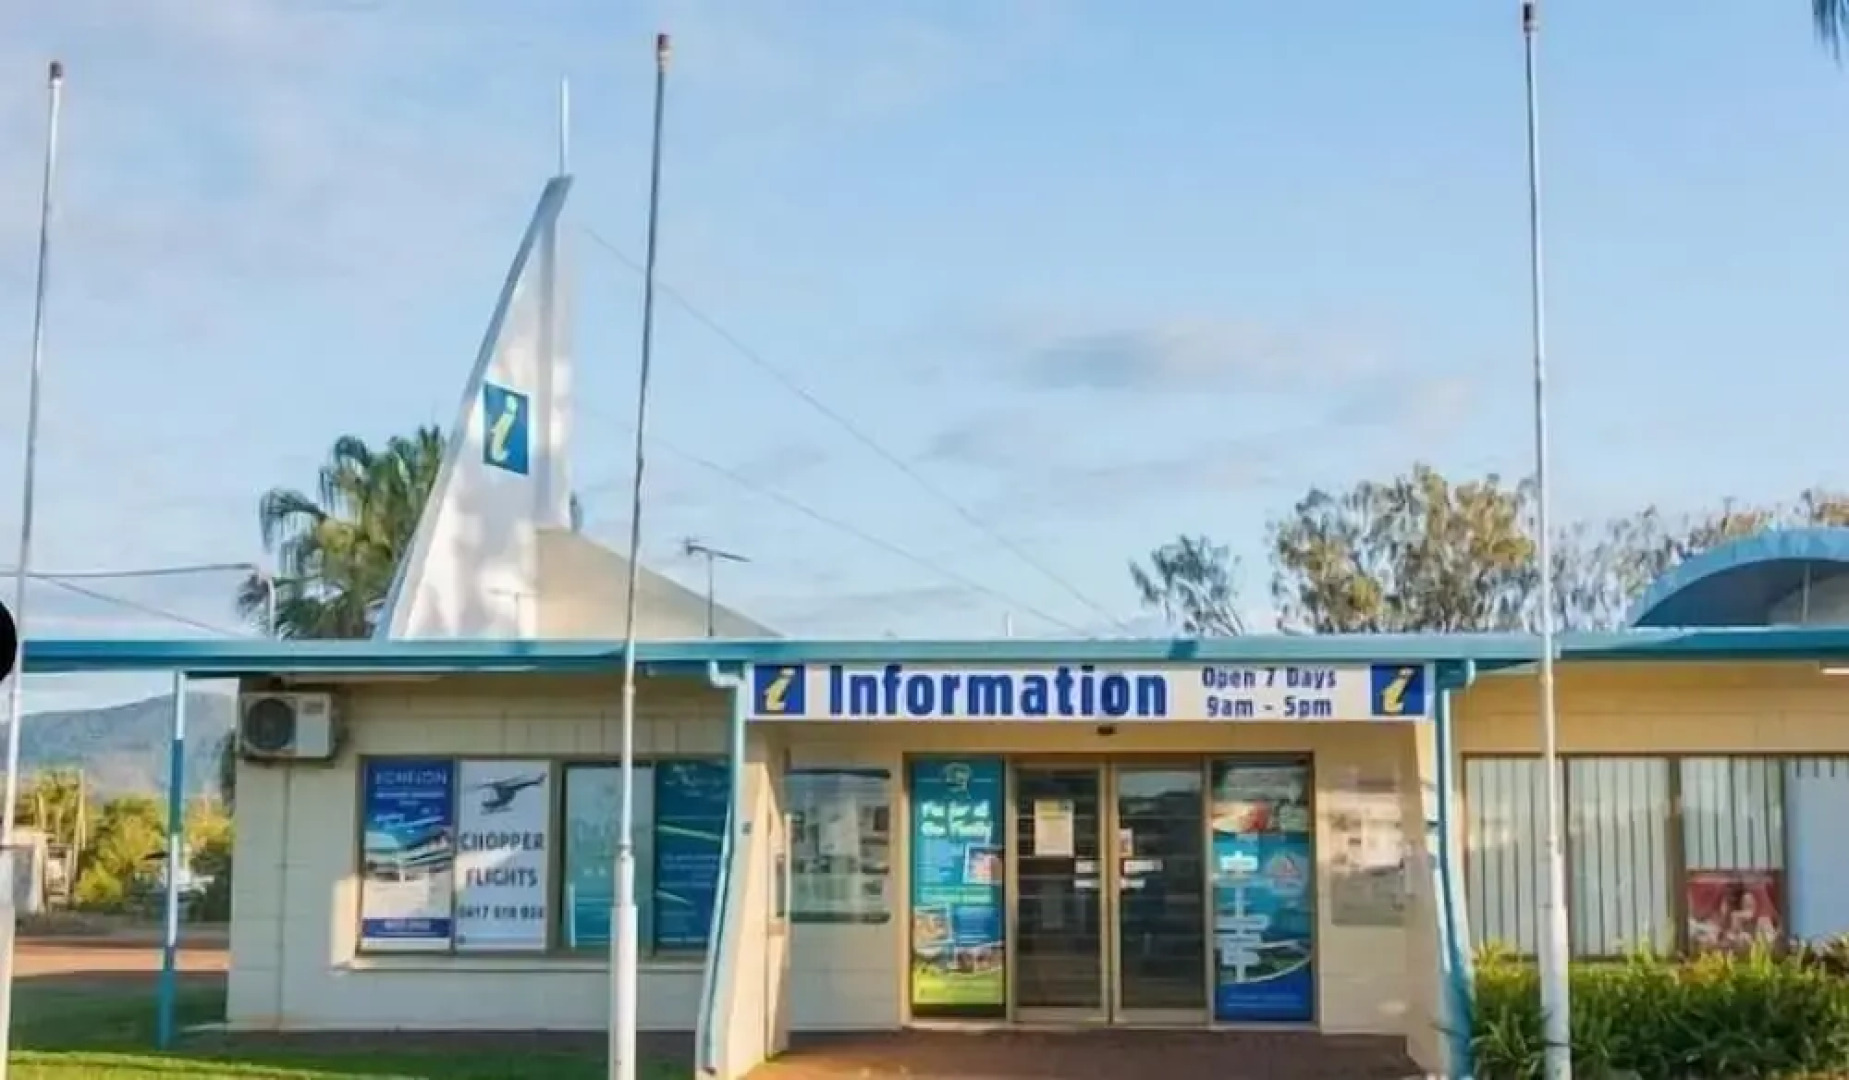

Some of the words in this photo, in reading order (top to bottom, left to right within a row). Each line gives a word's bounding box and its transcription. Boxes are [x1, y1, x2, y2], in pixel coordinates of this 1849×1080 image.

[1202, 666, 1256, 690] Open
[1264, 667, 1276, 688] 7
[1286, 667, 1337, 690] Days
[829, 664, 1168, 717] Information
[1206, 696, 1255, 718] 9am
[1284, 696, 1332, 719] 5pm
[459, 831, 544, 852] CHOPPER
[465, 866, 539, 889] FLIGHTS
